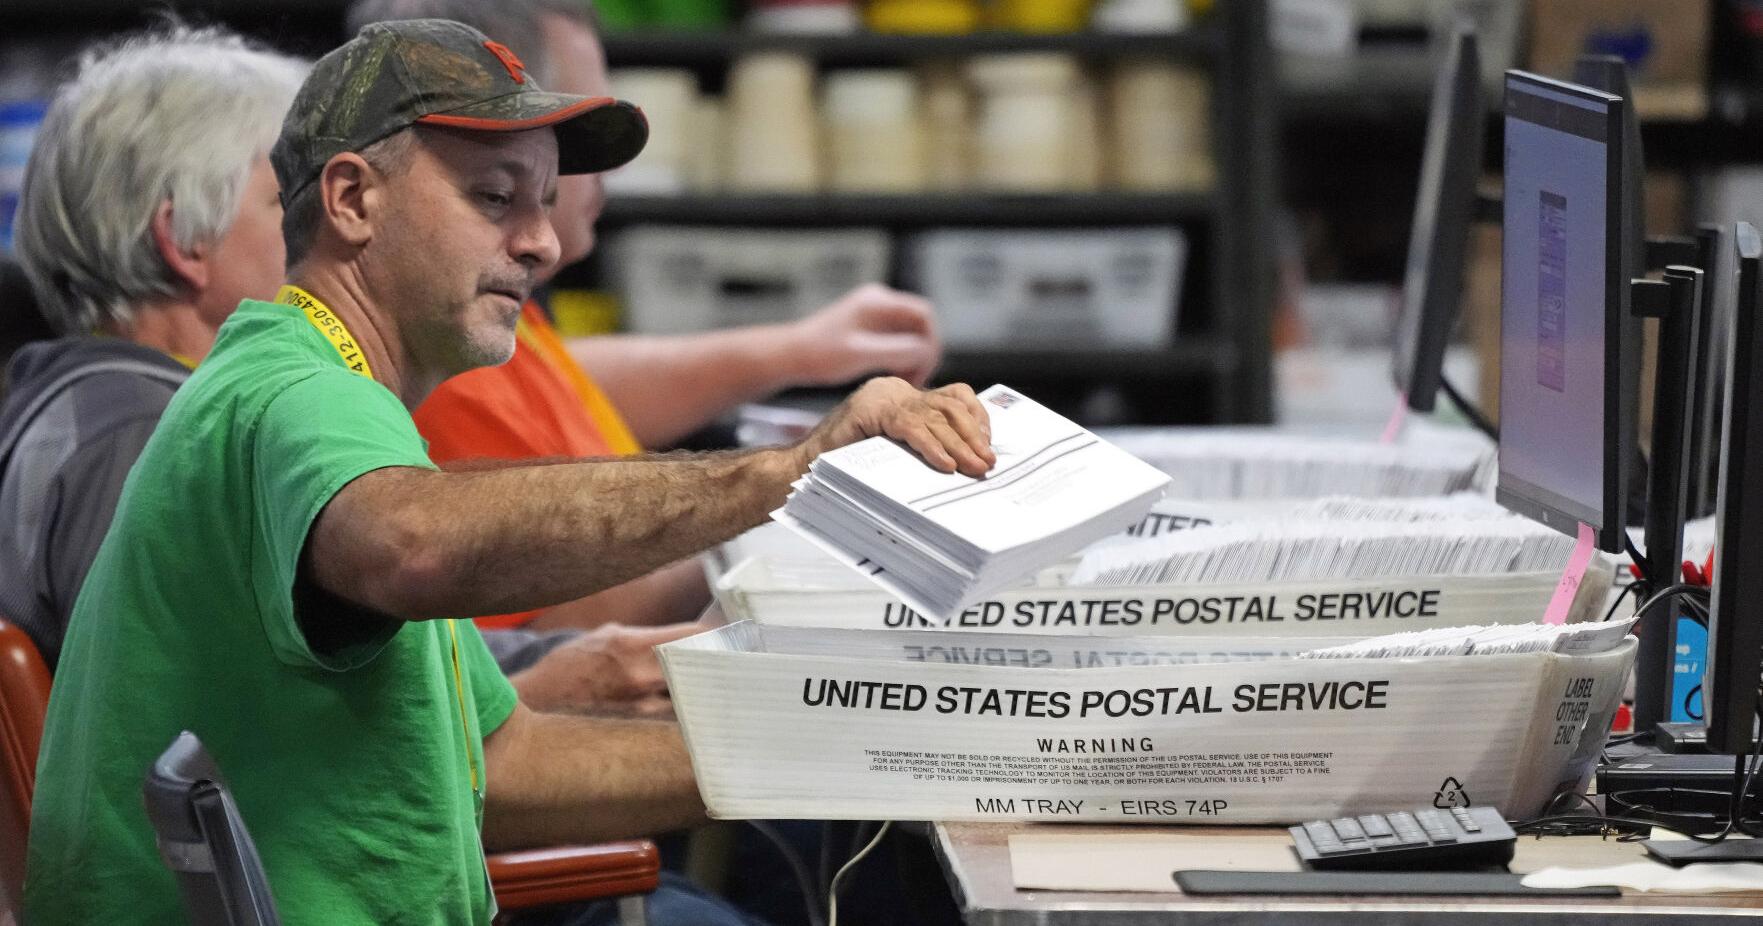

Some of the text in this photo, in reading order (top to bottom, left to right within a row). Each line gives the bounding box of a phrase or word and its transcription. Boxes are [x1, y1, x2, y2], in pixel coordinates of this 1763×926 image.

[1012, 599, 1143, 628] STATES
[1151, 595, 1285, 625] POSTAL
[1294, 590, 1441, 621] SERVICE
[1565, 678, 1594, 698] LABEL
[802, 678, 1390, 719] UNITED STATES POSTAL SERVICE
[1037, 737, 1154, 753] WARNING
[882, 750, 922, 758] EQUIPMENT
[969, 754, 988, 762] SOLD
[1179, 754, 1208, 762] POSTAL
[1272, 752, 1288, 760] THIS
[941, 760, 966, 768] OTHER
[1264, 760, 1292, 768] POSTAL
[890, 766, 934, 774] ELECTRONIC
[1200, 768, 1242, 776] VIOLATORS
[982, 776, 1037, 784] IMPRISONMENT
[975, 798, 1015, 814] MM
[1021, 799, 1084, 815] TRAY
[1120, 799, 1177, 816] EIRS
[1185, 799, 1228, 816] 74P
